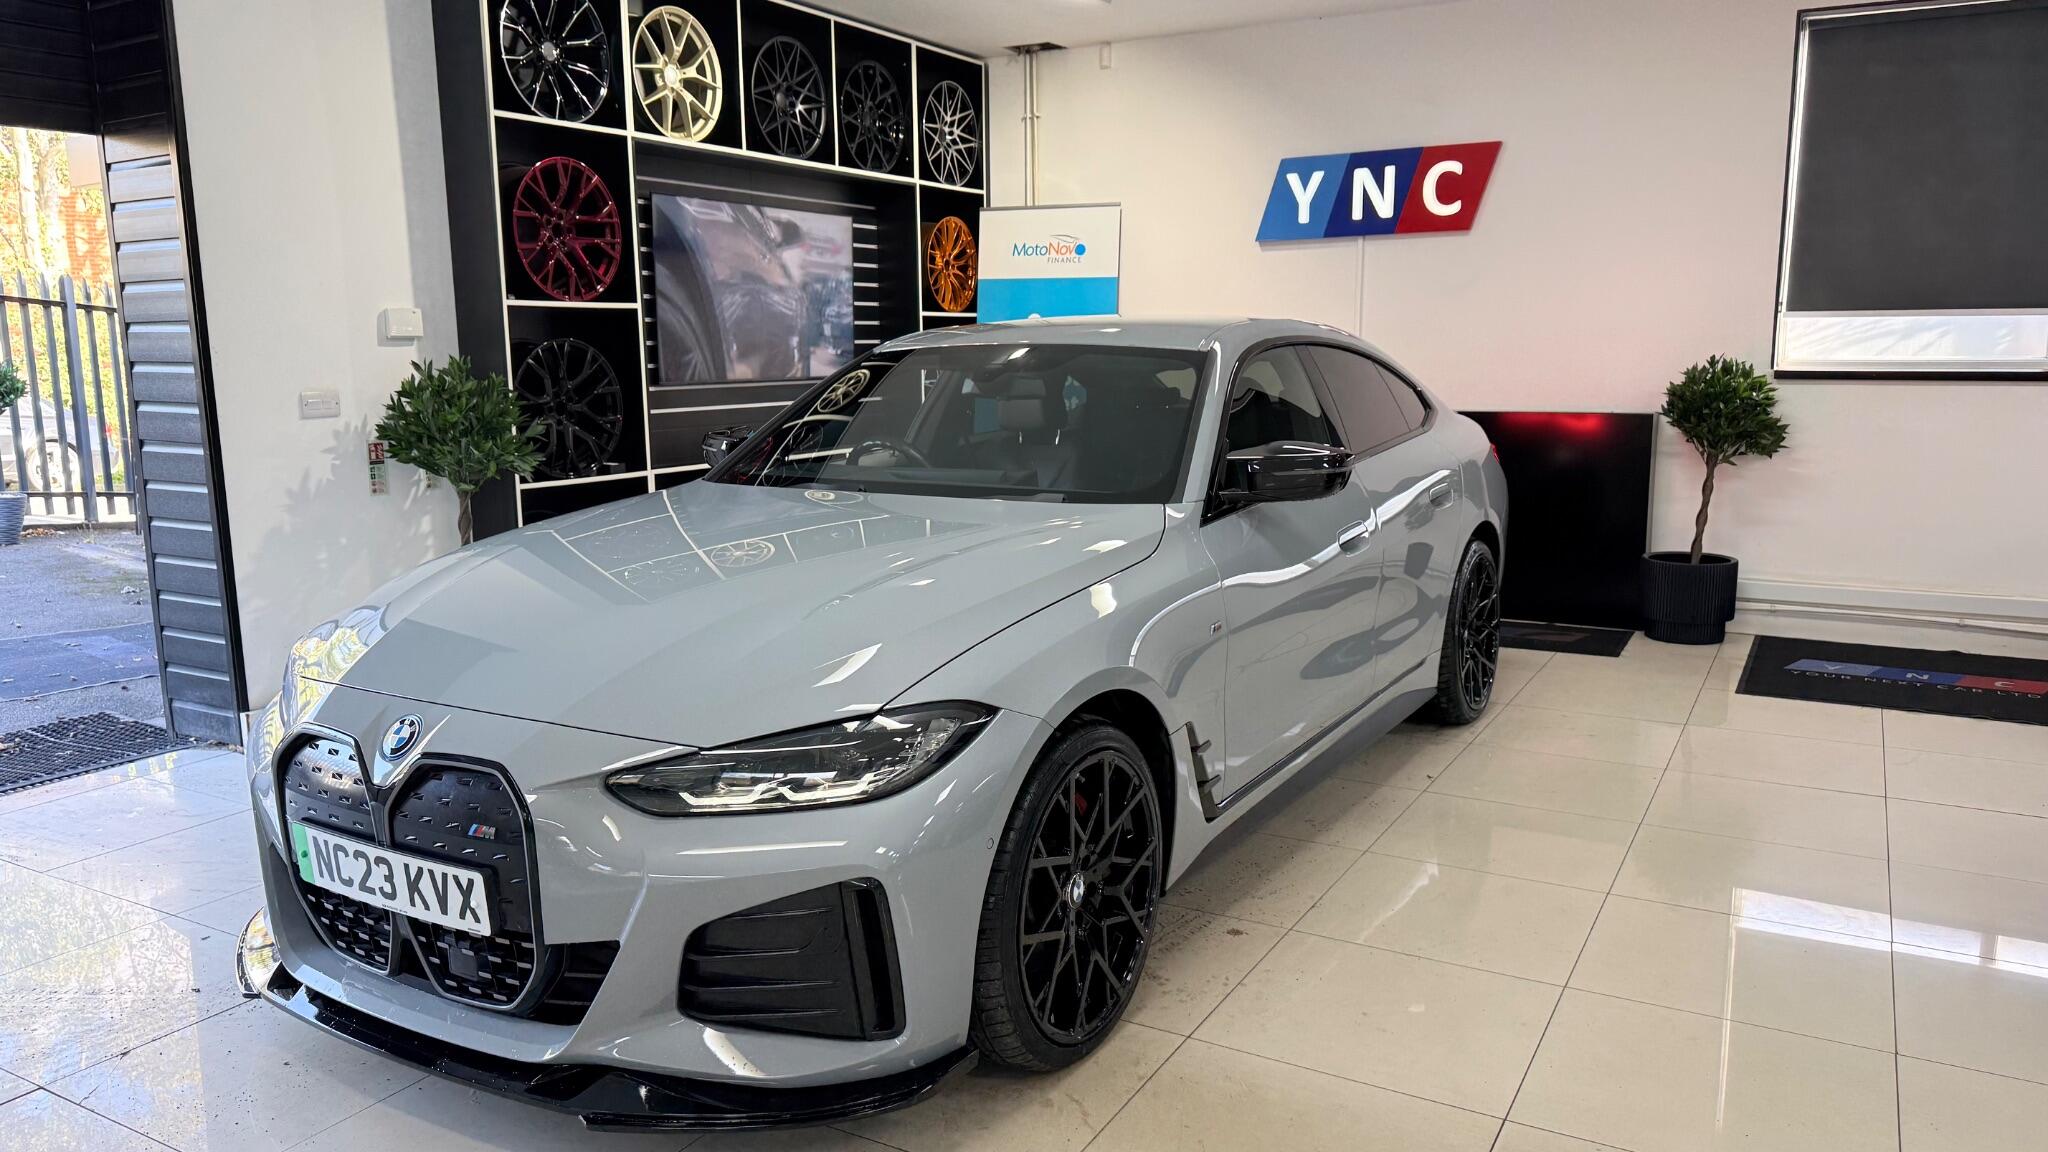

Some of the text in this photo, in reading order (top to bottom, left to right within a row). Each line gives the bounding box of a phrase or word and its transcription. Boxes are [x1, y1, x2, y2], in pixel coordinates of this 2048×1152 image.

[1286, 160, 1463, 224] YNC
[1047, 256, 1082, 264] FINANCE
[312, 835, 481, 924] NC23 KVX
